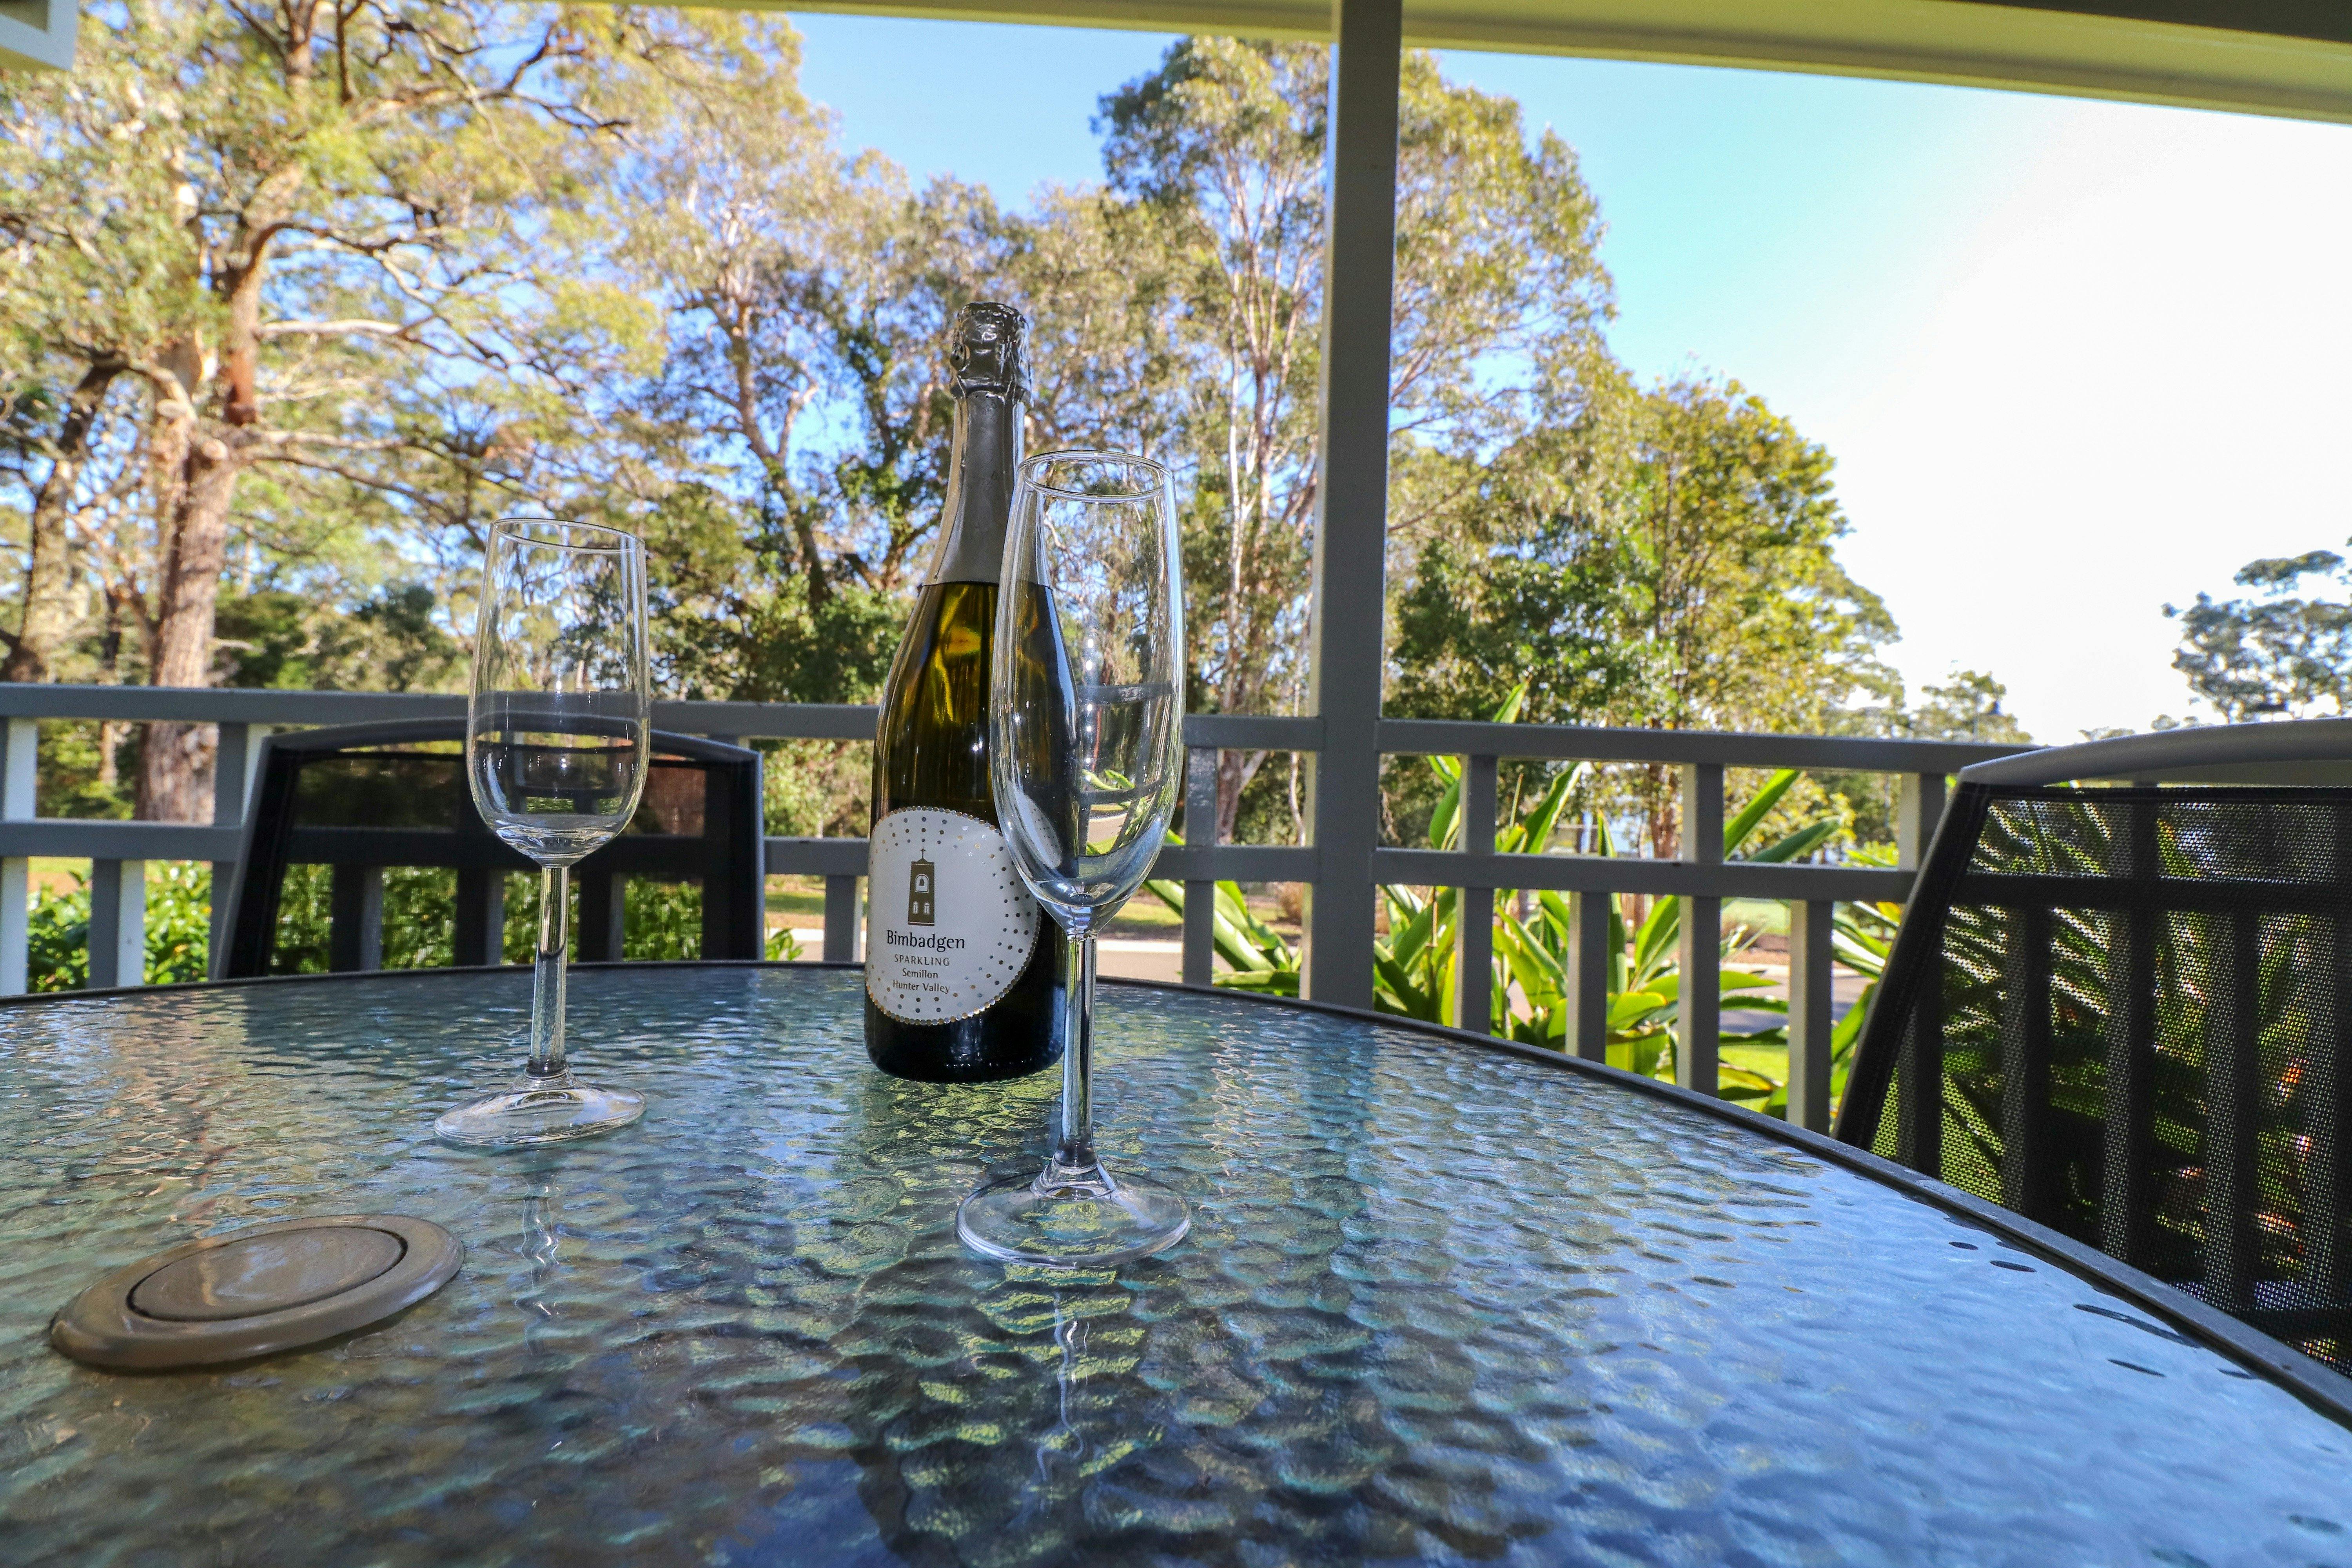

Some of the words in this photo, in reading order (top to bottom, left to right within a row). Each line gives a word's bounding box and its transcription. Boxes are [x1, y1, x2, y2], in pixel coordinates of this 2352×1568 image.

[887, 929, 965, 953] Bimbadgen
[894, 954, 950, 966] SPARKLING
[902, 968, 938, 979] Semillon
[893, 979, 920, 991] Hunter
[922, 982, 950, 995] Valley
